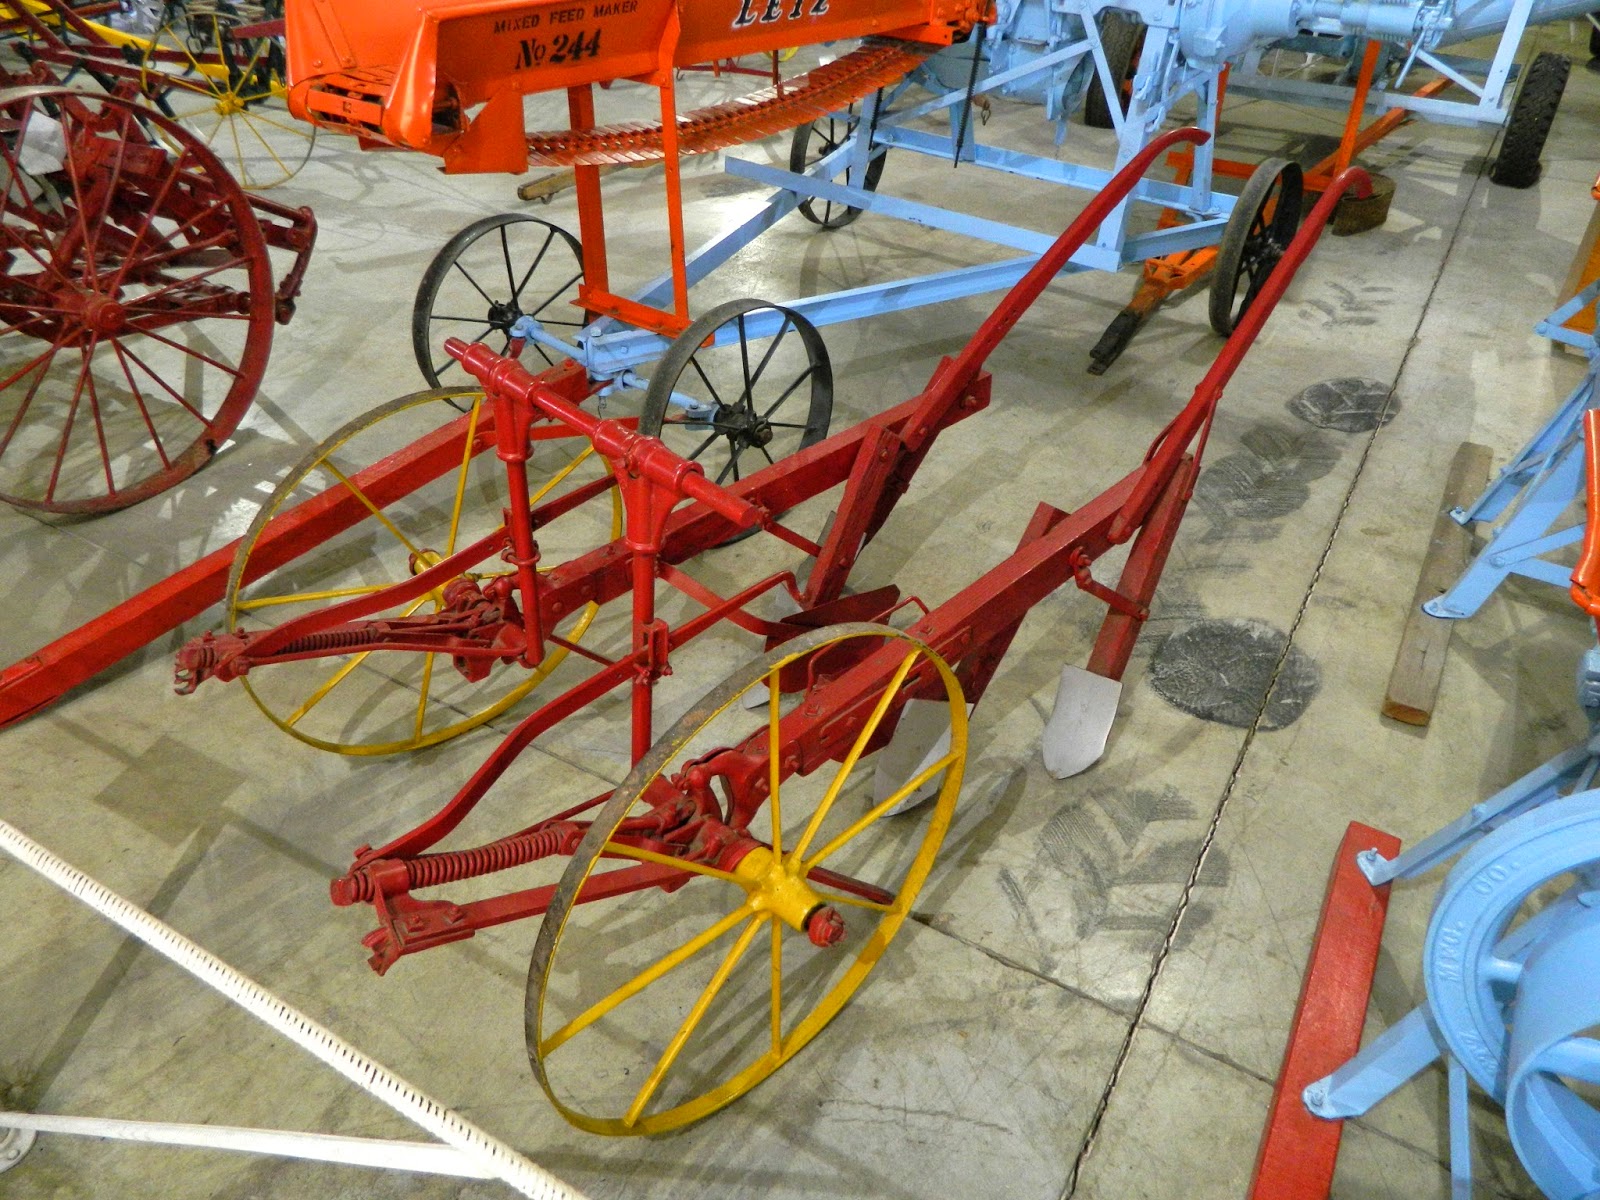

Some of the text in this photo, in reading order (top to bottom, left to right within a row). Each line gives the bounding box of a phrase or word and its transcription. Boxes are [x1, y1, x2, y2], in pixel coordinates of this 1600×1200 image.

[494, 0, 638, 34] MIXED FEED MAKER
[550, 29, 601, 63] 244
